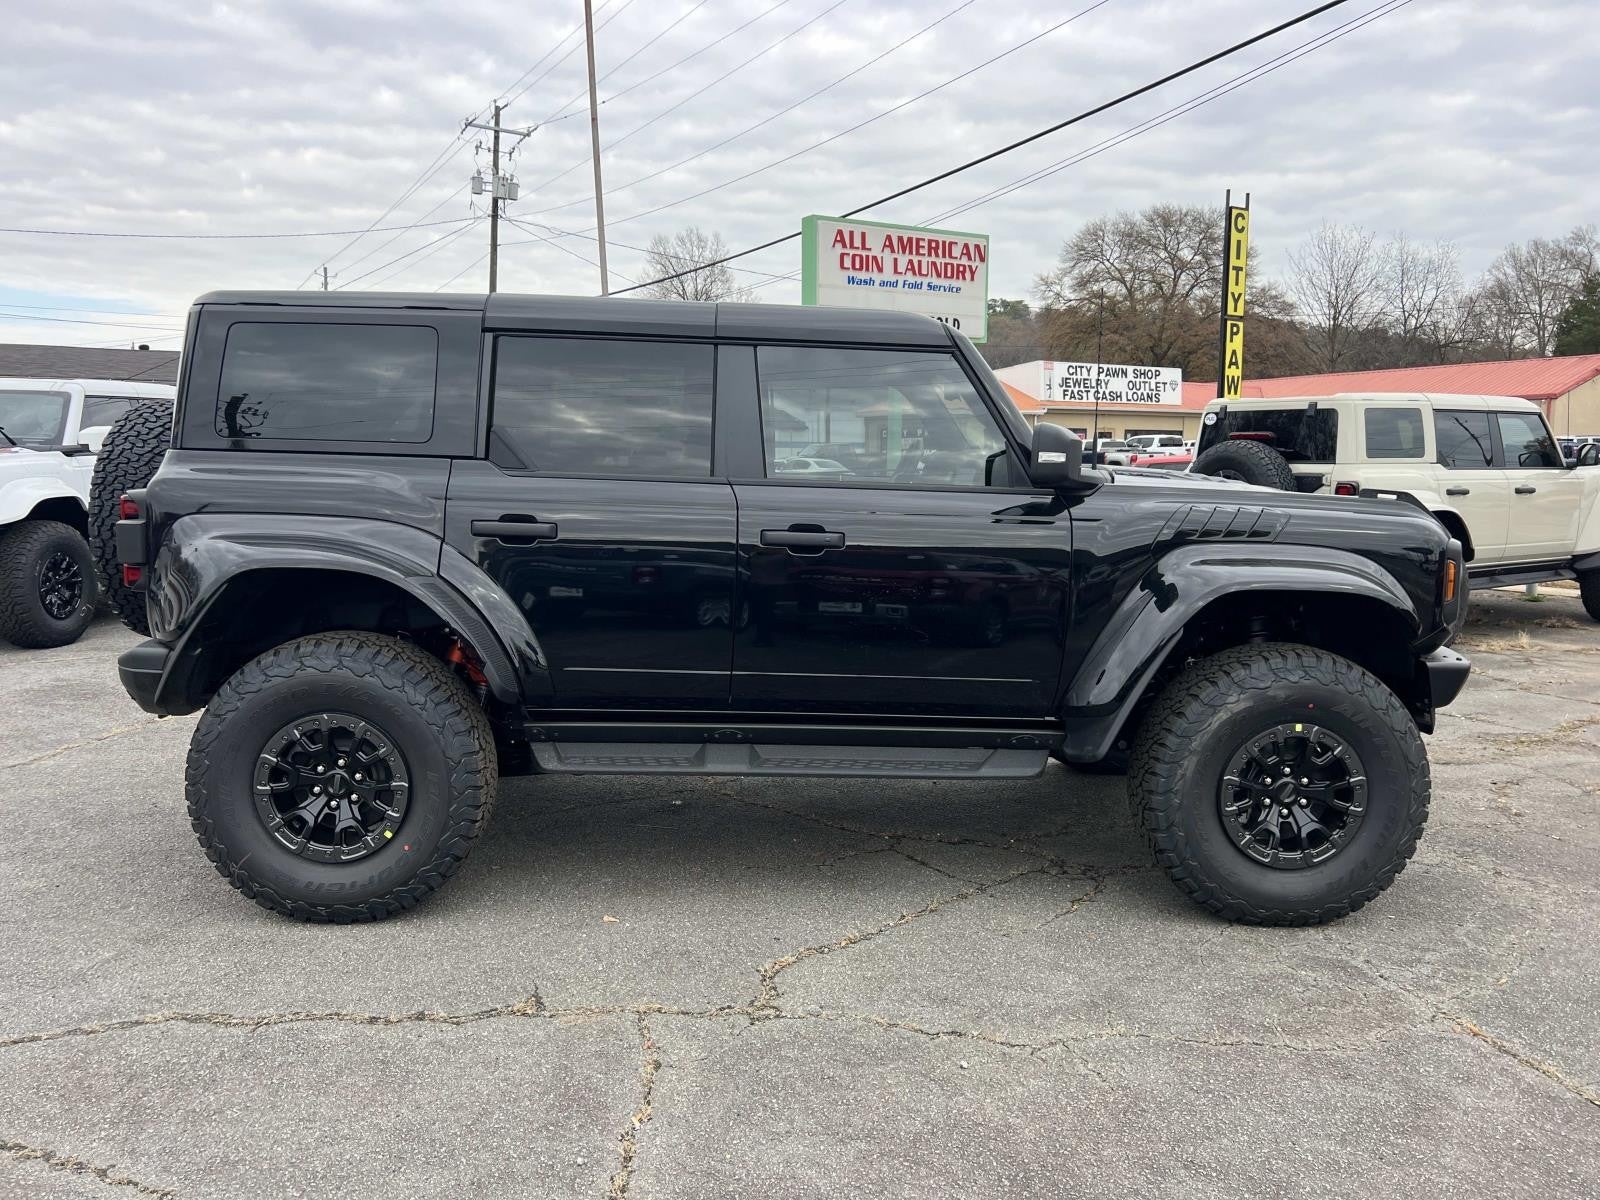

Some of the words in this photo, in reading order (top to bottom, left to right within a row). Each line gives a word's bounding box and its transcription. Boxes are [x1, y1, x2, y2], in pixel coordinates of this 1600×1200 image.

[832, 229, 871, 251] ALL
[881, 234, 986, 262] AMERICAN
[839, 252, 884, 273] COIN
[893, 258, 978, 281] LAUNDRY
[1231, 212, 1246, 312] CITY
[847, 275, 875, 286] Wash
[879, 278, 898, 289] and
[902, 279, 923, 290] Fold
[926, 281, 962, 294] Service
[1067, 364, 1093, 377] CITY
[1098, 366, 1128, 379] PAWN
[1132, 368, 1161, 380] SHOP
[1058, 377, 1110, 390] JEWELRY
[1127, 380, 1168, 392] OUTLET
[1062, 389, 1091, 401] FAST
[1093, 390, 1123, 402] CASH
[1126, 391, 1161, 403] LOANS
